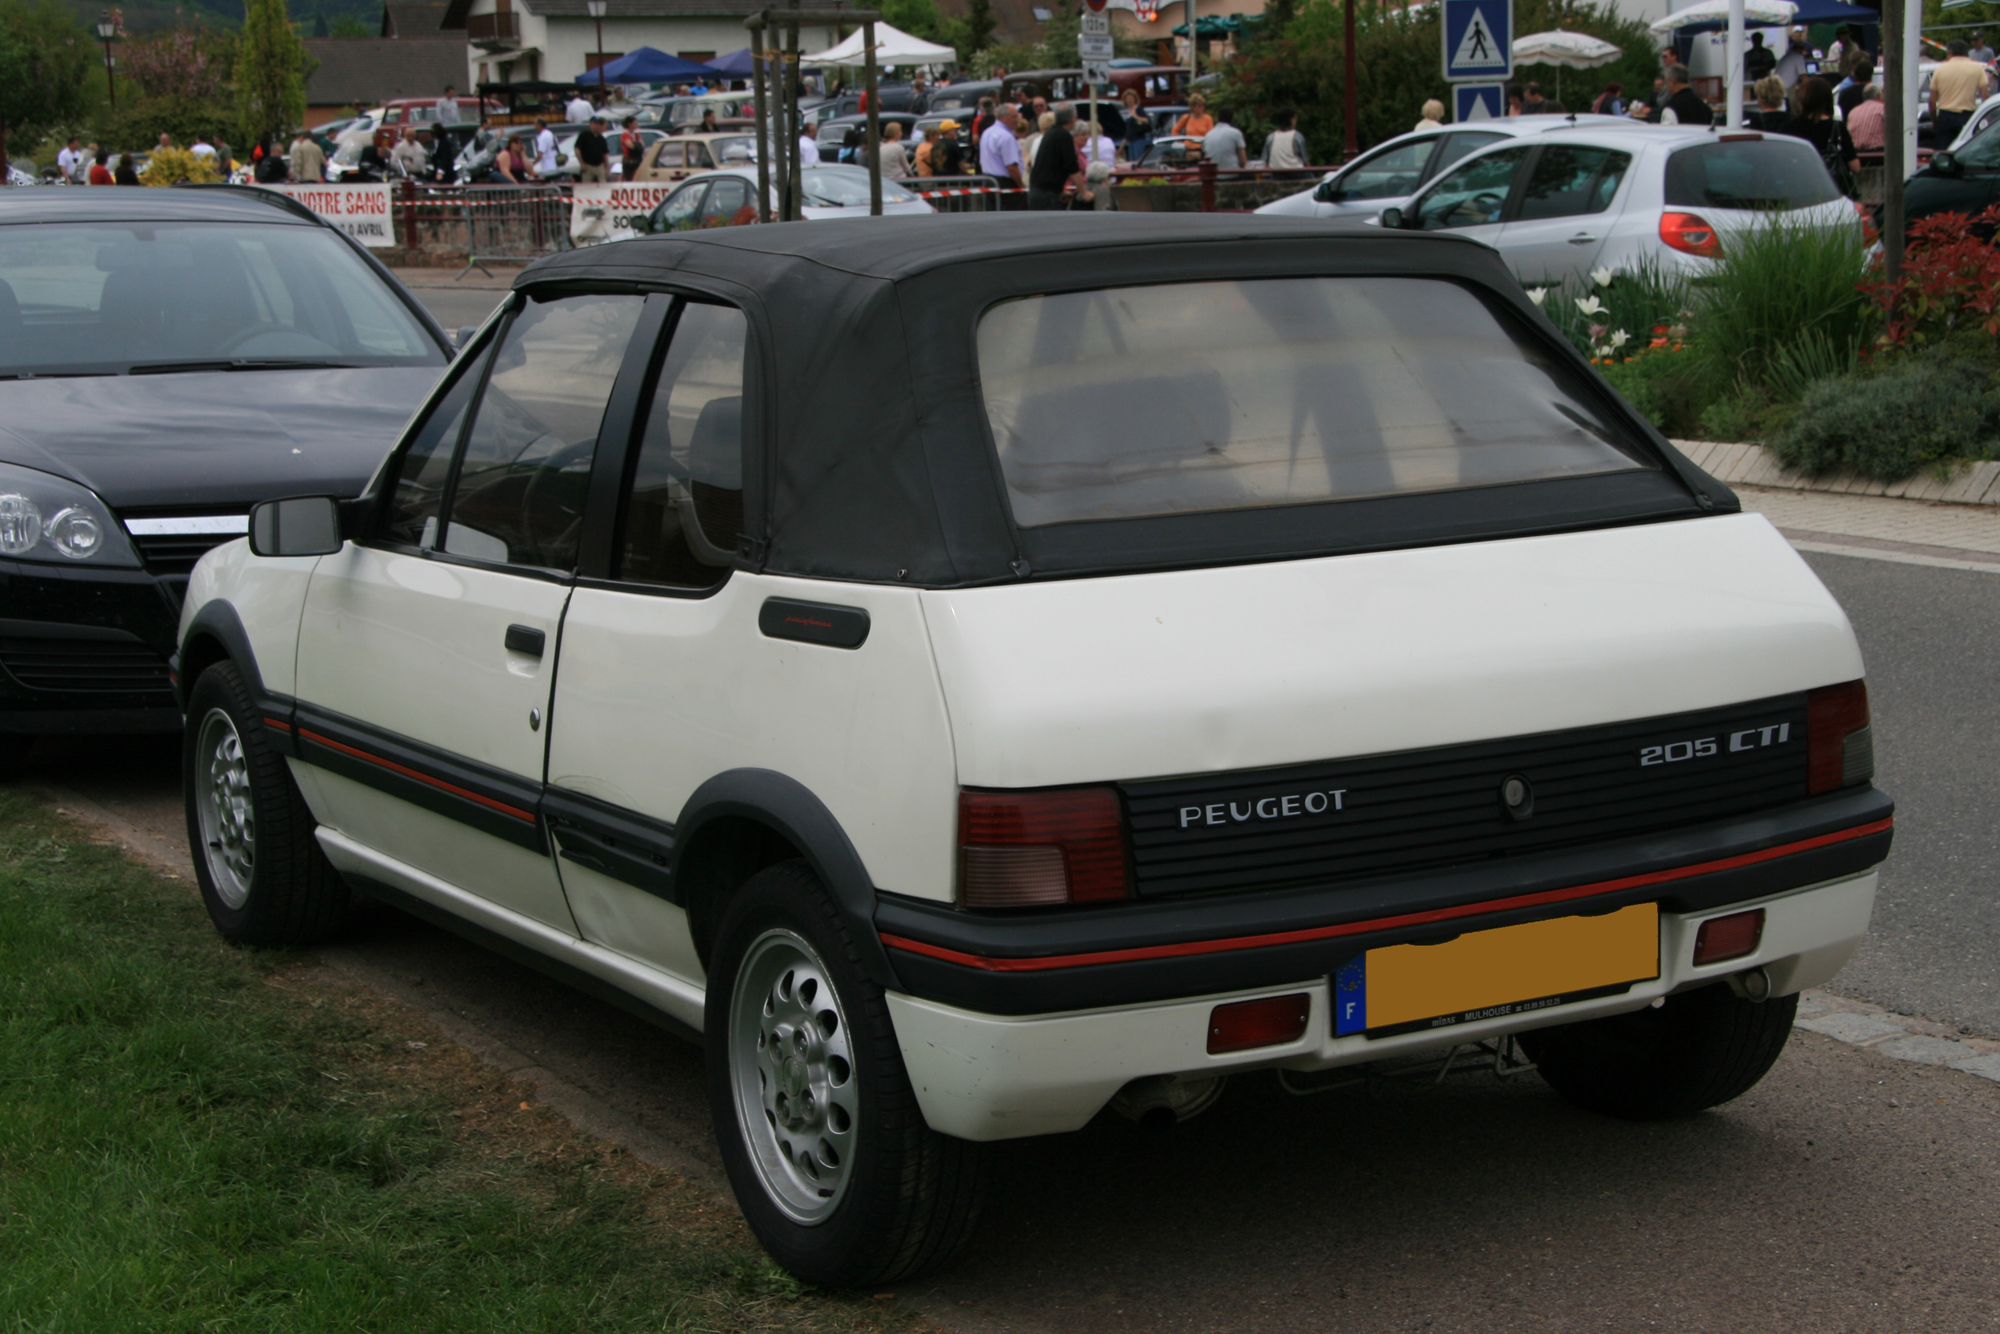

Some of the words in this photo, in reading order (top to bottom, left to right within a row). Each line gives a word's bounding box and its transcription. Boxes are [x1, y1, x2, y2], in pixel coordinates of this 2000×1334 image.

[298, 191, 342, 214] VOTRE
[346, 191, 387, 214] SANG
[356, 222, 384, 236] AVRIL
[1640, 736, 1718, 767] 205
[1729, 722, 1790, 753] CTI
[1179, 789, 1348, 828] PEUGEOT
[1346, 1002, 1356, 1020] F
[1464, 1005, 1512, 1021] MULHOUSE
